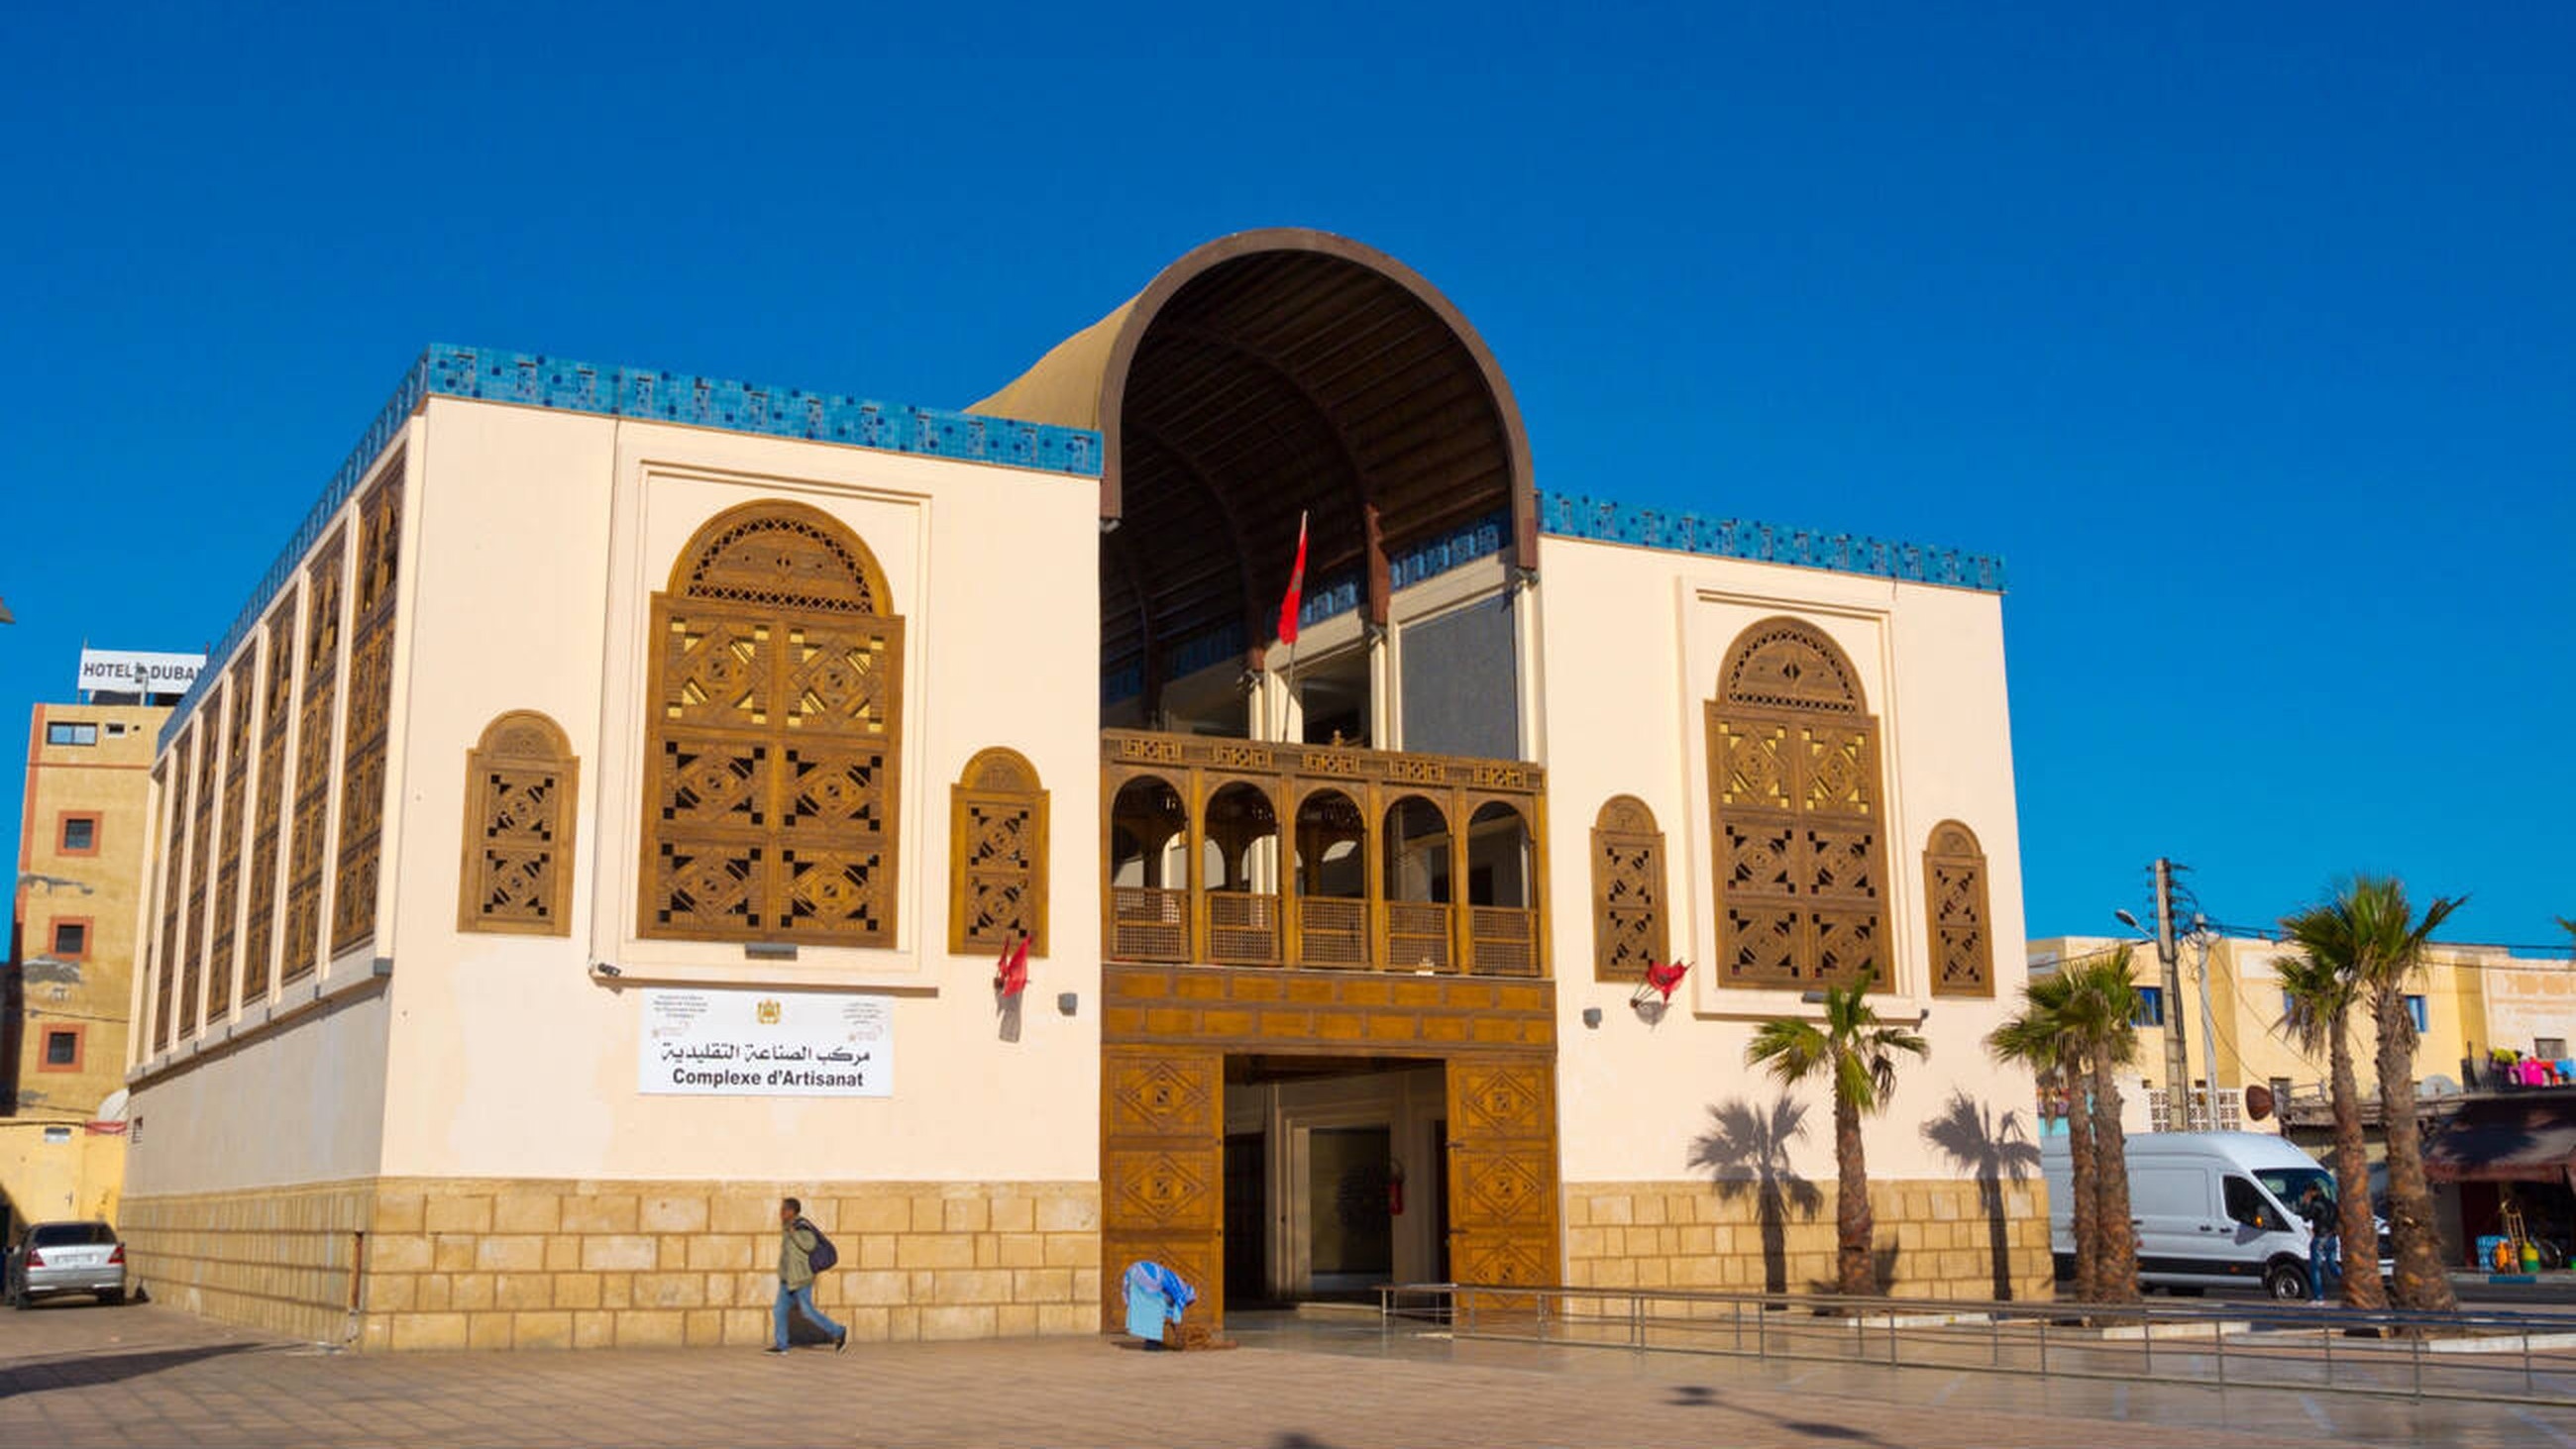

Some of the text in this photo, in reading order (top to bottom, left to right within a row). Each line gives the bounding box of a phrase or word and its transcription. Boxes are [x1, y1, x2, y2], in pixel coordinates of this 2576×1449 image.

[83, 663, 133, 677] HOTEL
[661, 1041, 871, 1067] مركب الصناعة التقليدية
[673, 1069, 864, 1088] Complexe d'Artisanat
